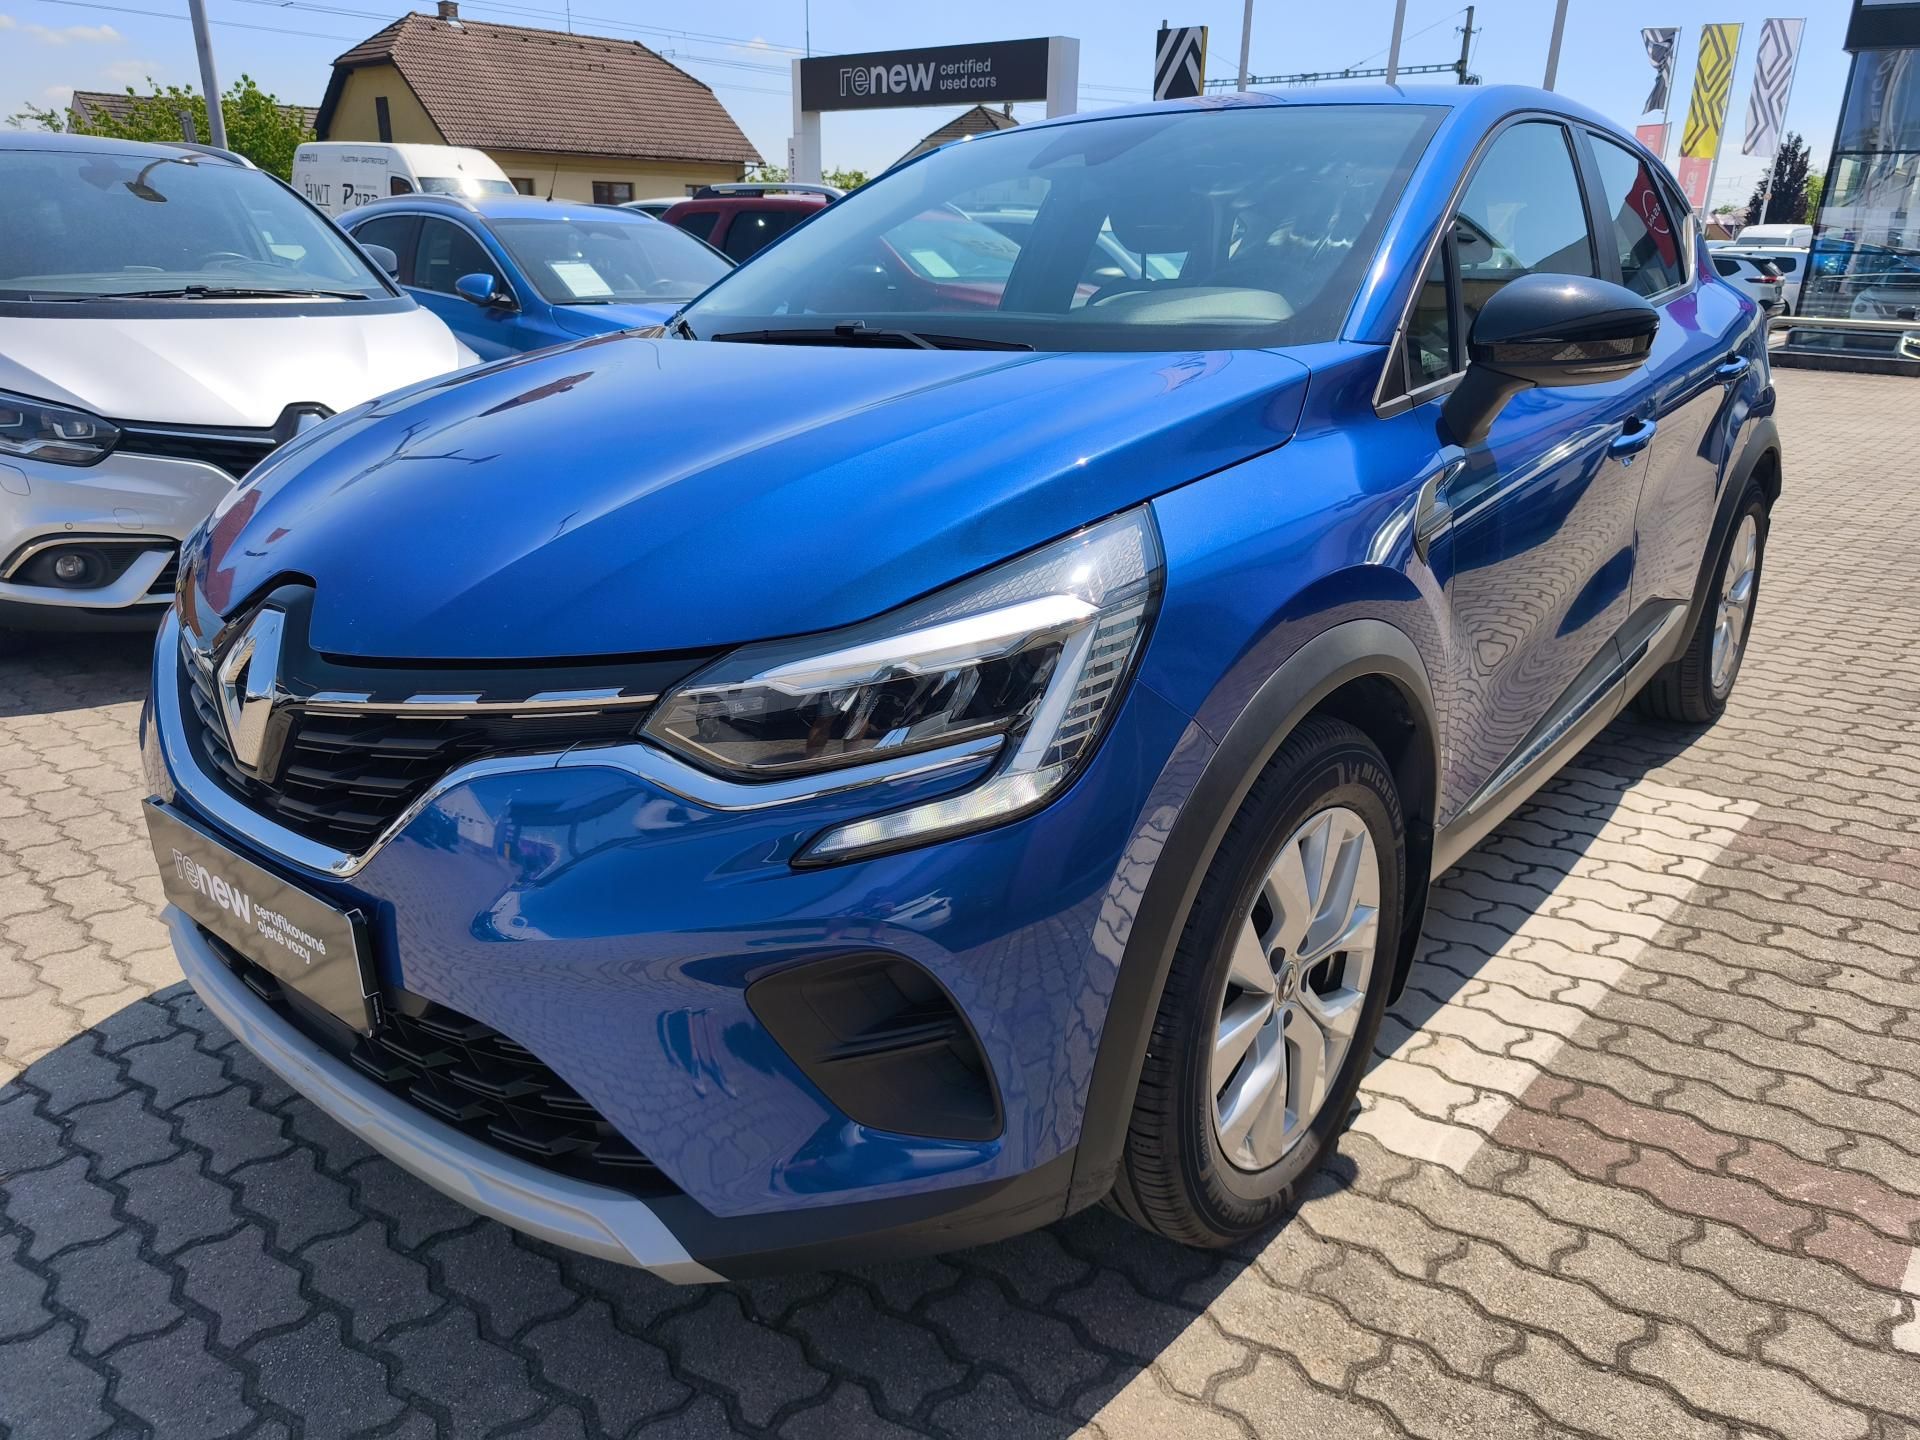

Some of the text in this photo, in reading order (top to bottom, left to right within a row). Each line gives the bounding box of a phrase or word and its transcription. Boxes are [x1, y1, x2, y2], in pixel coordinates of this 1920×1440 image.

[840, 62, 936, 97] renew
[940, 57, 991, 75] certified
[940, 75, 997, 90] used cars
[1361, 762, 1402, 830] MICHELIN
[172, 848, 250, 924] renew
[253, 903, 326, 956] certifikované
[257, 920, 311, 965] ojeté vozy
